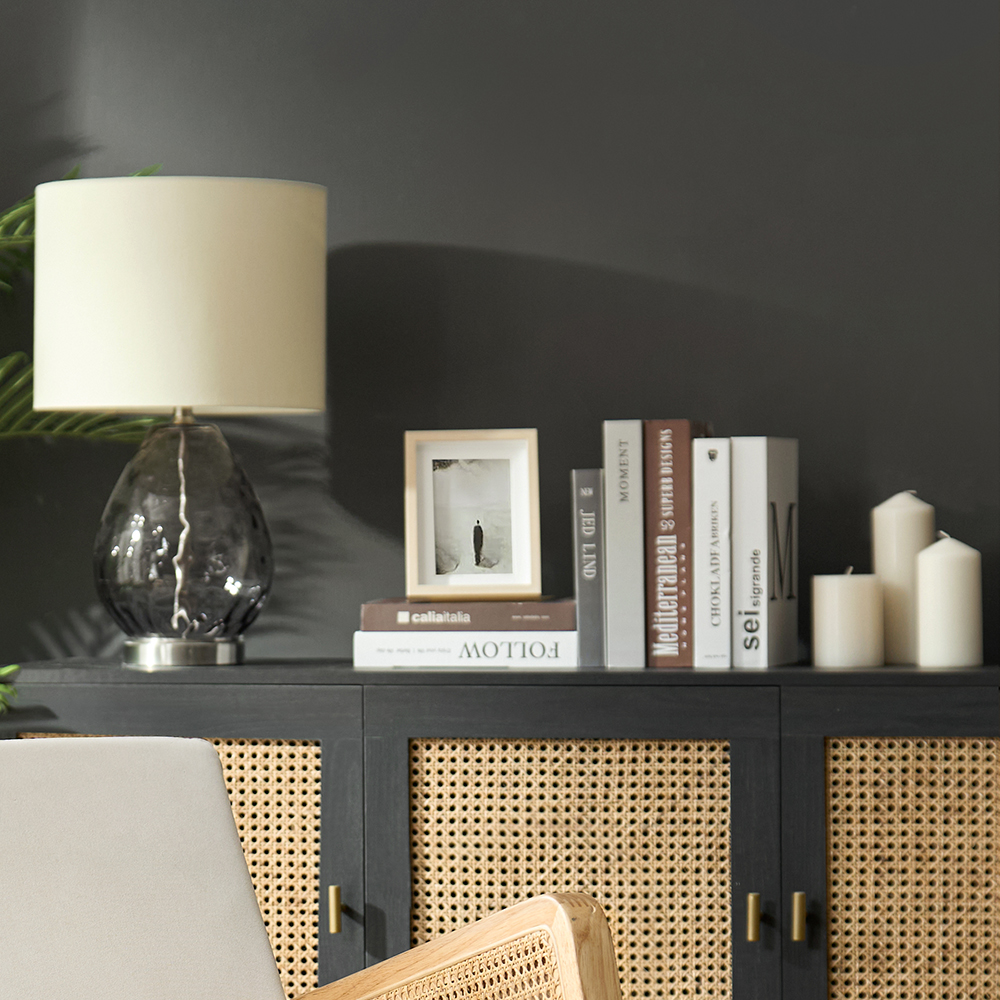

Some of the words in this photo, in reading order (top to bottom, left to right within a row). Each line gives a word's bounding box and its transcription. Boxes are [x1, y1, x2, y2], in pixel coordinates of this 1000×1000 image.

[618, 439, 629, 503] MOMENT
[660, 427, 673, 474] DESIGNS
[660, 477, 674, 518] SUPERB
[579, 509, 596, 535] JED
[582, 543, 597, 579] LIND
[651, 534, 680, 657] Mediterranean
[737, 609, 761, 651] sei
[750, 548, 763, 607] sigrande
[458, 641, 560, 659] FOLLOW
